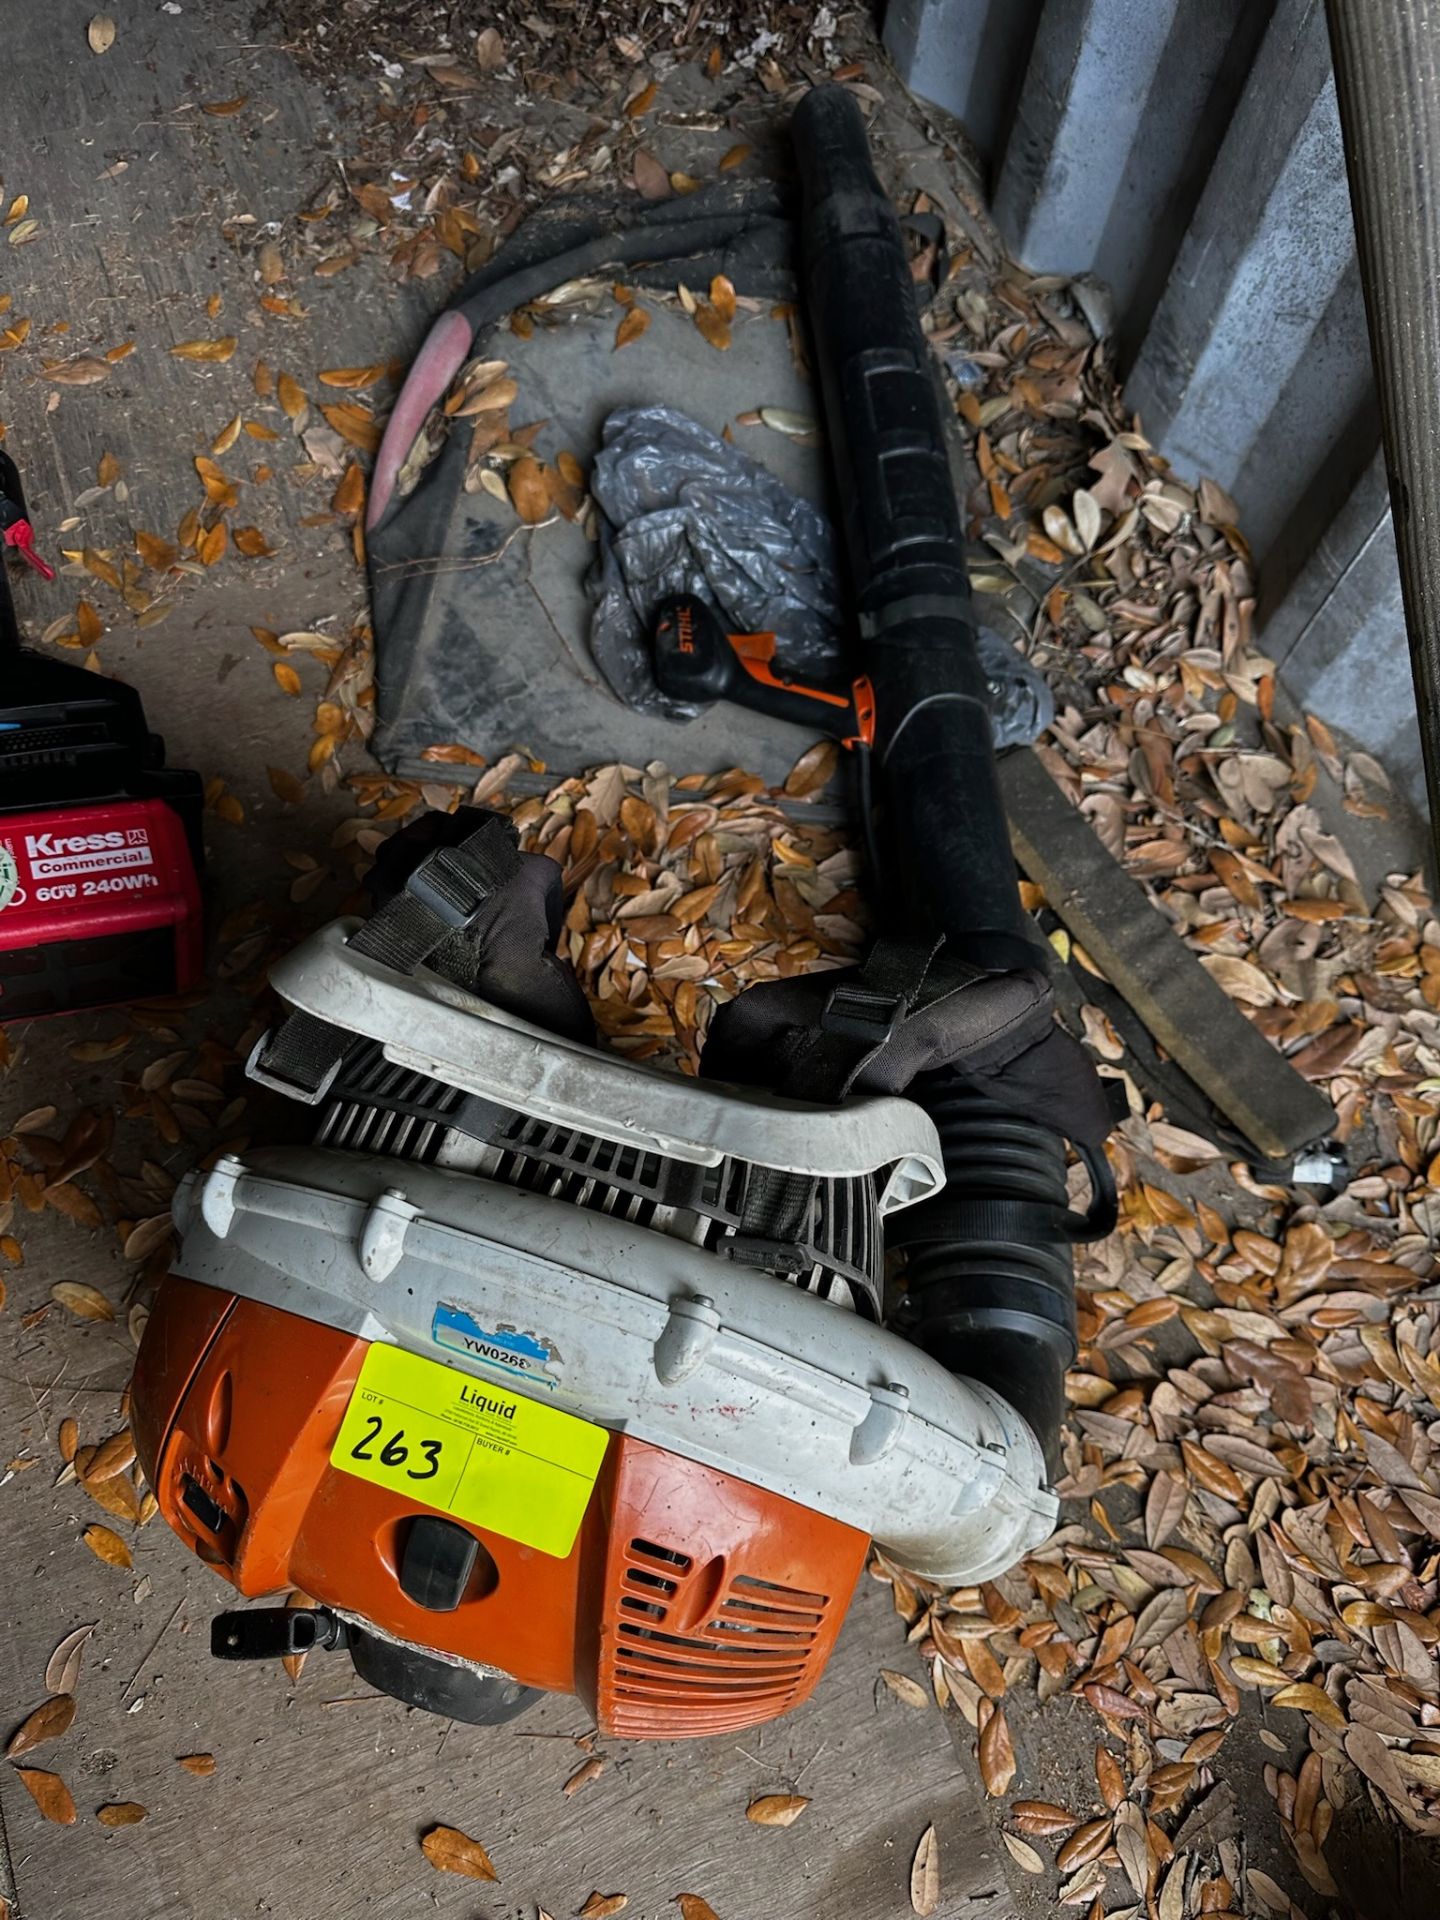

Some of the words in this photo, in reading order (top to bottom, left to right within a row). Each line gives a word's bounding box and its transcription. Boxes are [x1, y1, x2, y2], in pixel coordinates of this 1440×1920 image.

[676, 606, 694, 654] STIHL
[24, 831, 125, 859] Kress
[38, 851, 143, 874] Commercial
[35, 884, 77, 902] 60V
[81, 873, 160, 896] 240Wh
[361, 1392, 378, 1403] LOT
[459, 1385, 517, 1420] Liquid
[350, 1416, 442, 1479] 263
[476, 1437, 504, 1454] BUYER
